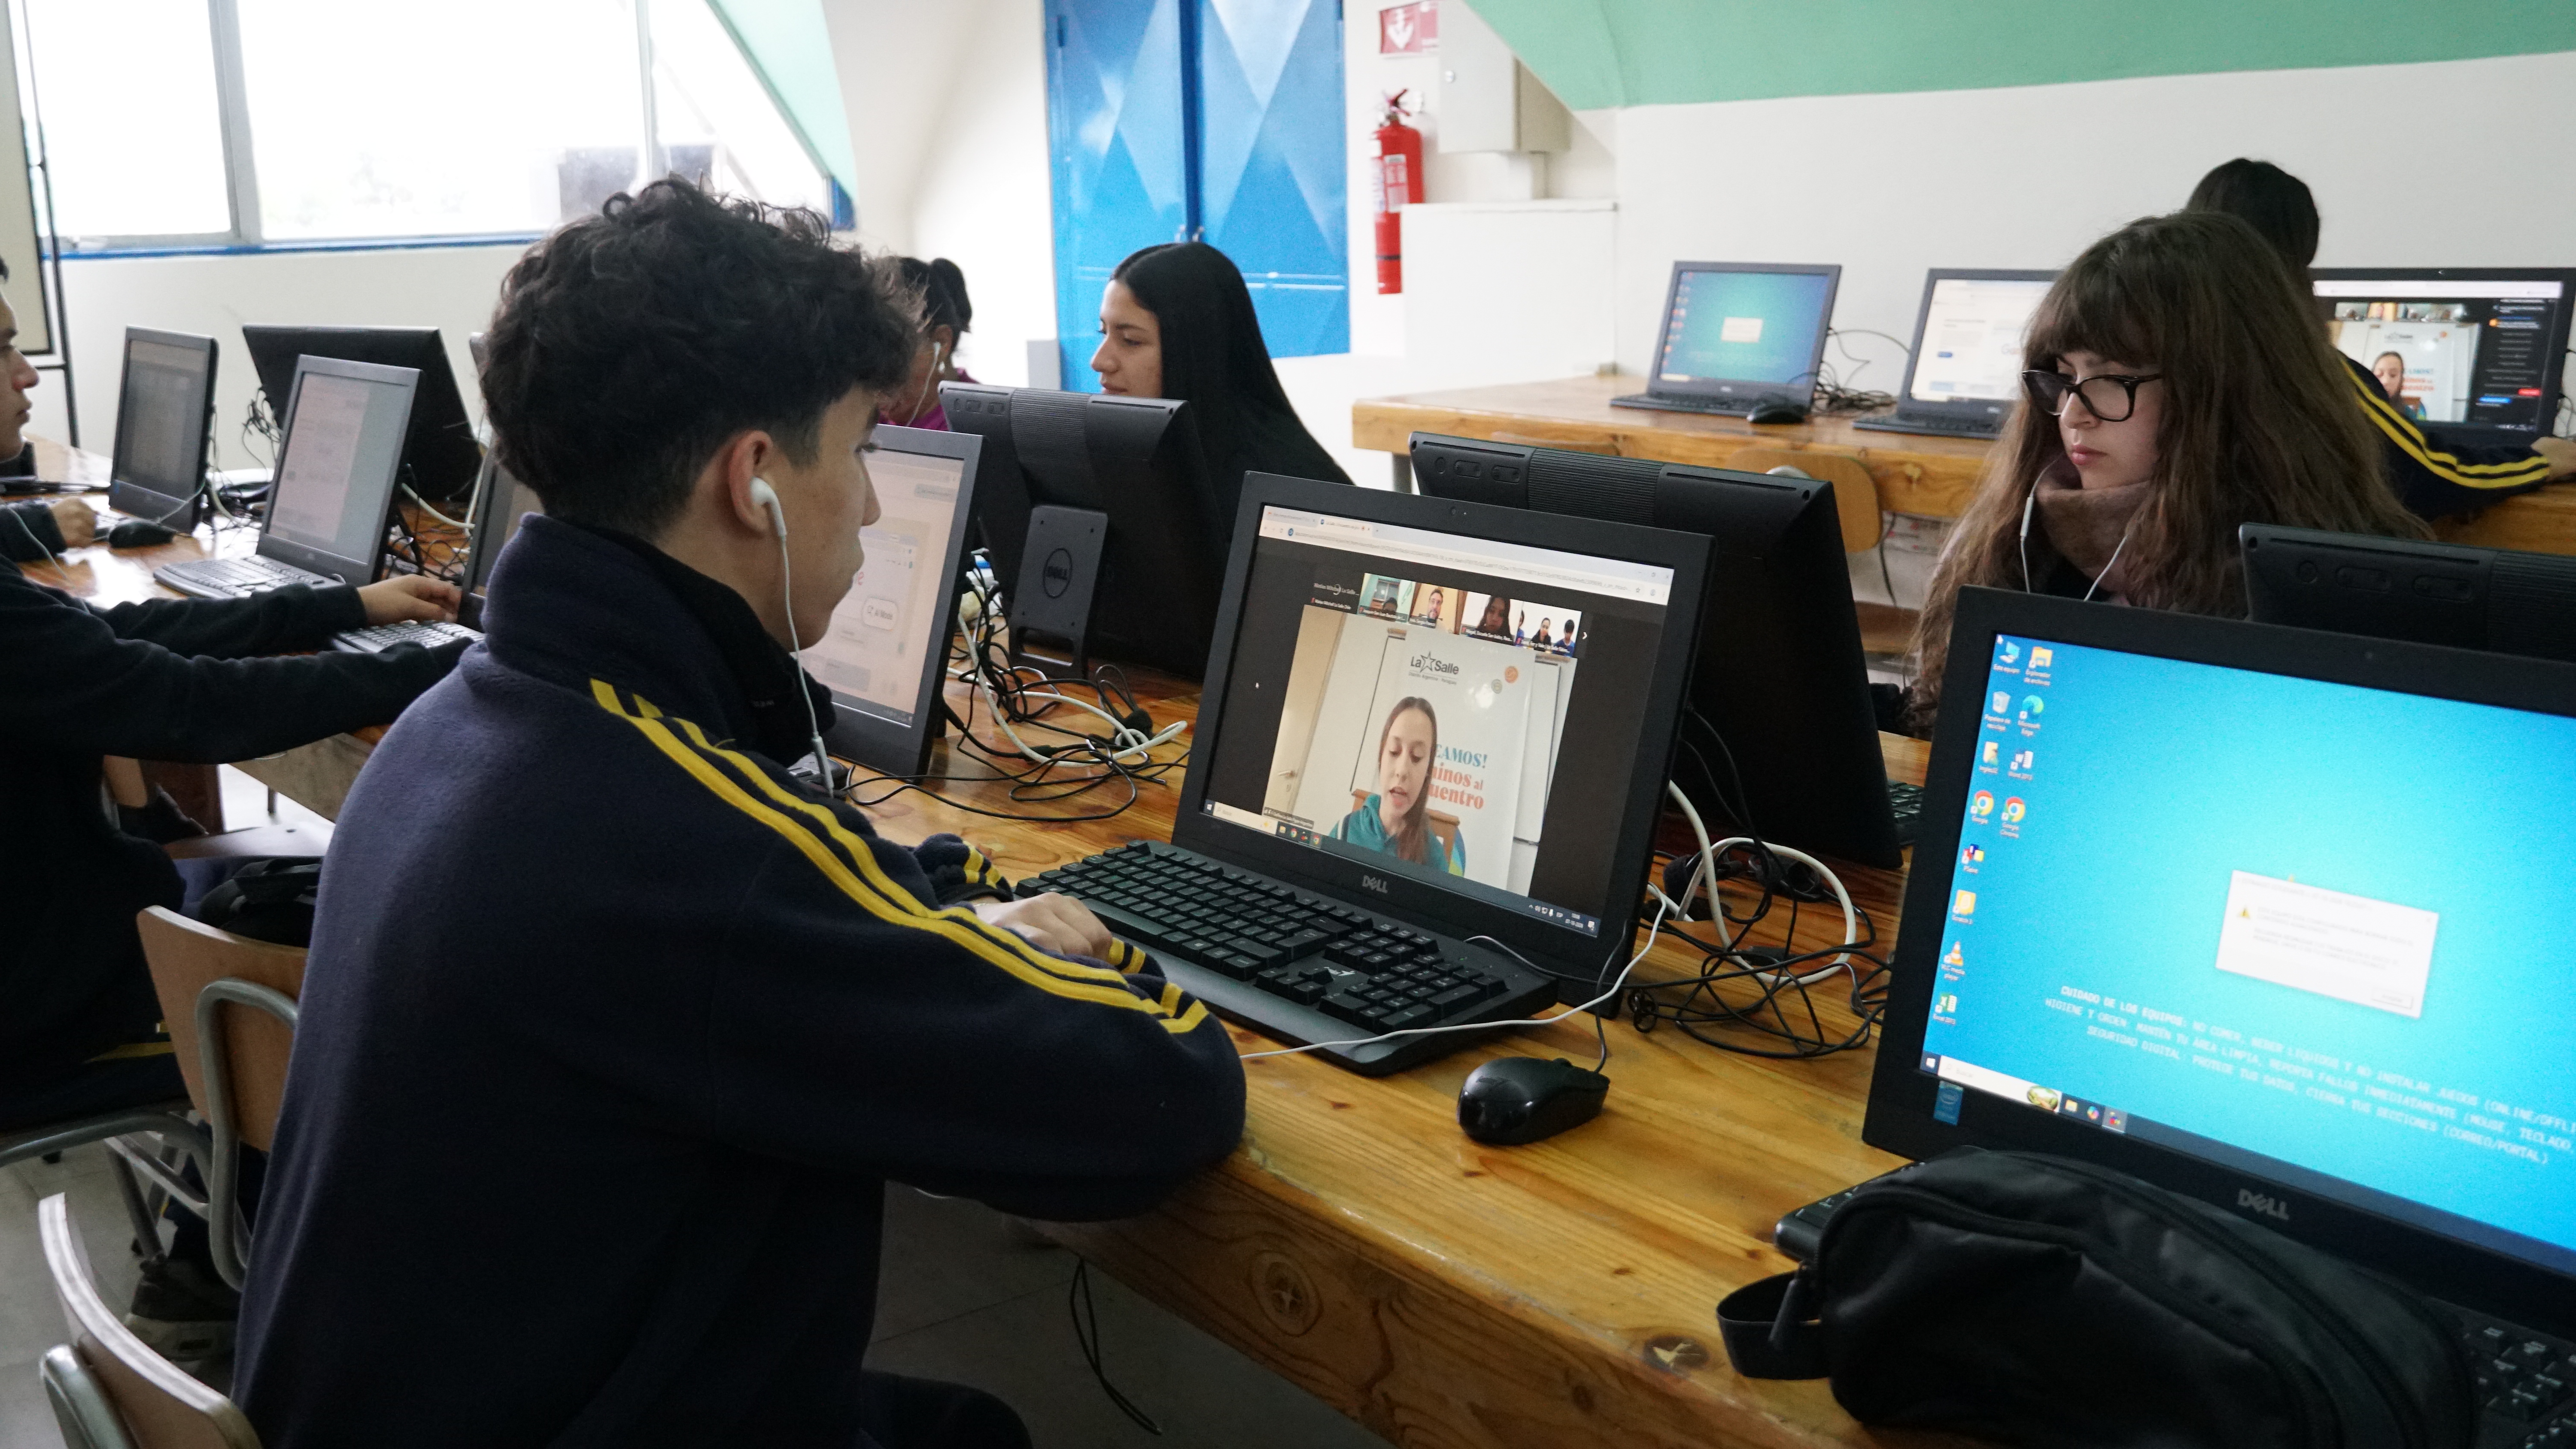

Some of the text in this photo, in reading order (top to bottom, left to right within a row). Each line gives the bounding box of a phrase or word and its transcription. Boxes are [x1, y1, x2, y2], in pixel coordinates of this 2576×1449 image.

[881, 610, 893, 620] Mode
[1410, 656, 1459, 675] La Salle
[1474, 779, 1483, 790] al
[1362, 875, 1388, 894] DELL
[2061, 986, 2100, 1004] CUIDADO
[2104, 997, 2116, 1009] DE
[2120, 1001, 2138, 1014] LOS
[2088, 1009, 2094, 1019] Y
[2087, 1025, 2138, 1048] SEGURIDAD
[2237, 1188, 2290, 1220] DELL
